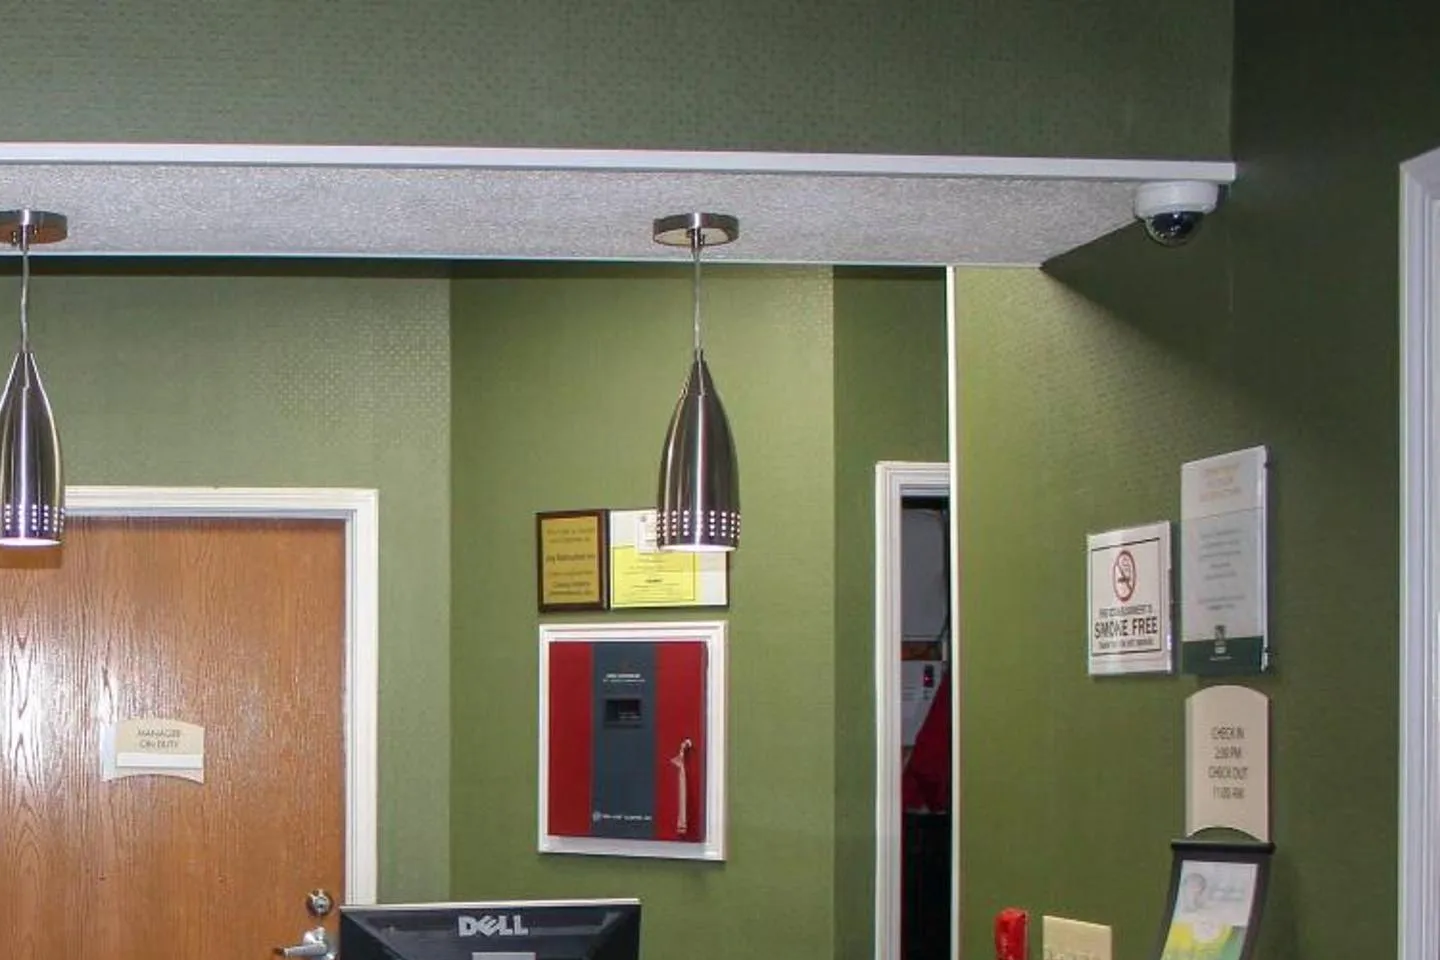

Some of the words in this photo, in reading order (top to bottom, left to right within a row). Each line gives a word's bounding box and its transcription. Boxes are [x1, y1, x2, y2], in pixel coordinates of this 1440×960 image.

[1094, 619, 1128, 639] SMOKE
[1132, 616, 1158, 636] FREE
[458, 915, 529, 936] DELL
